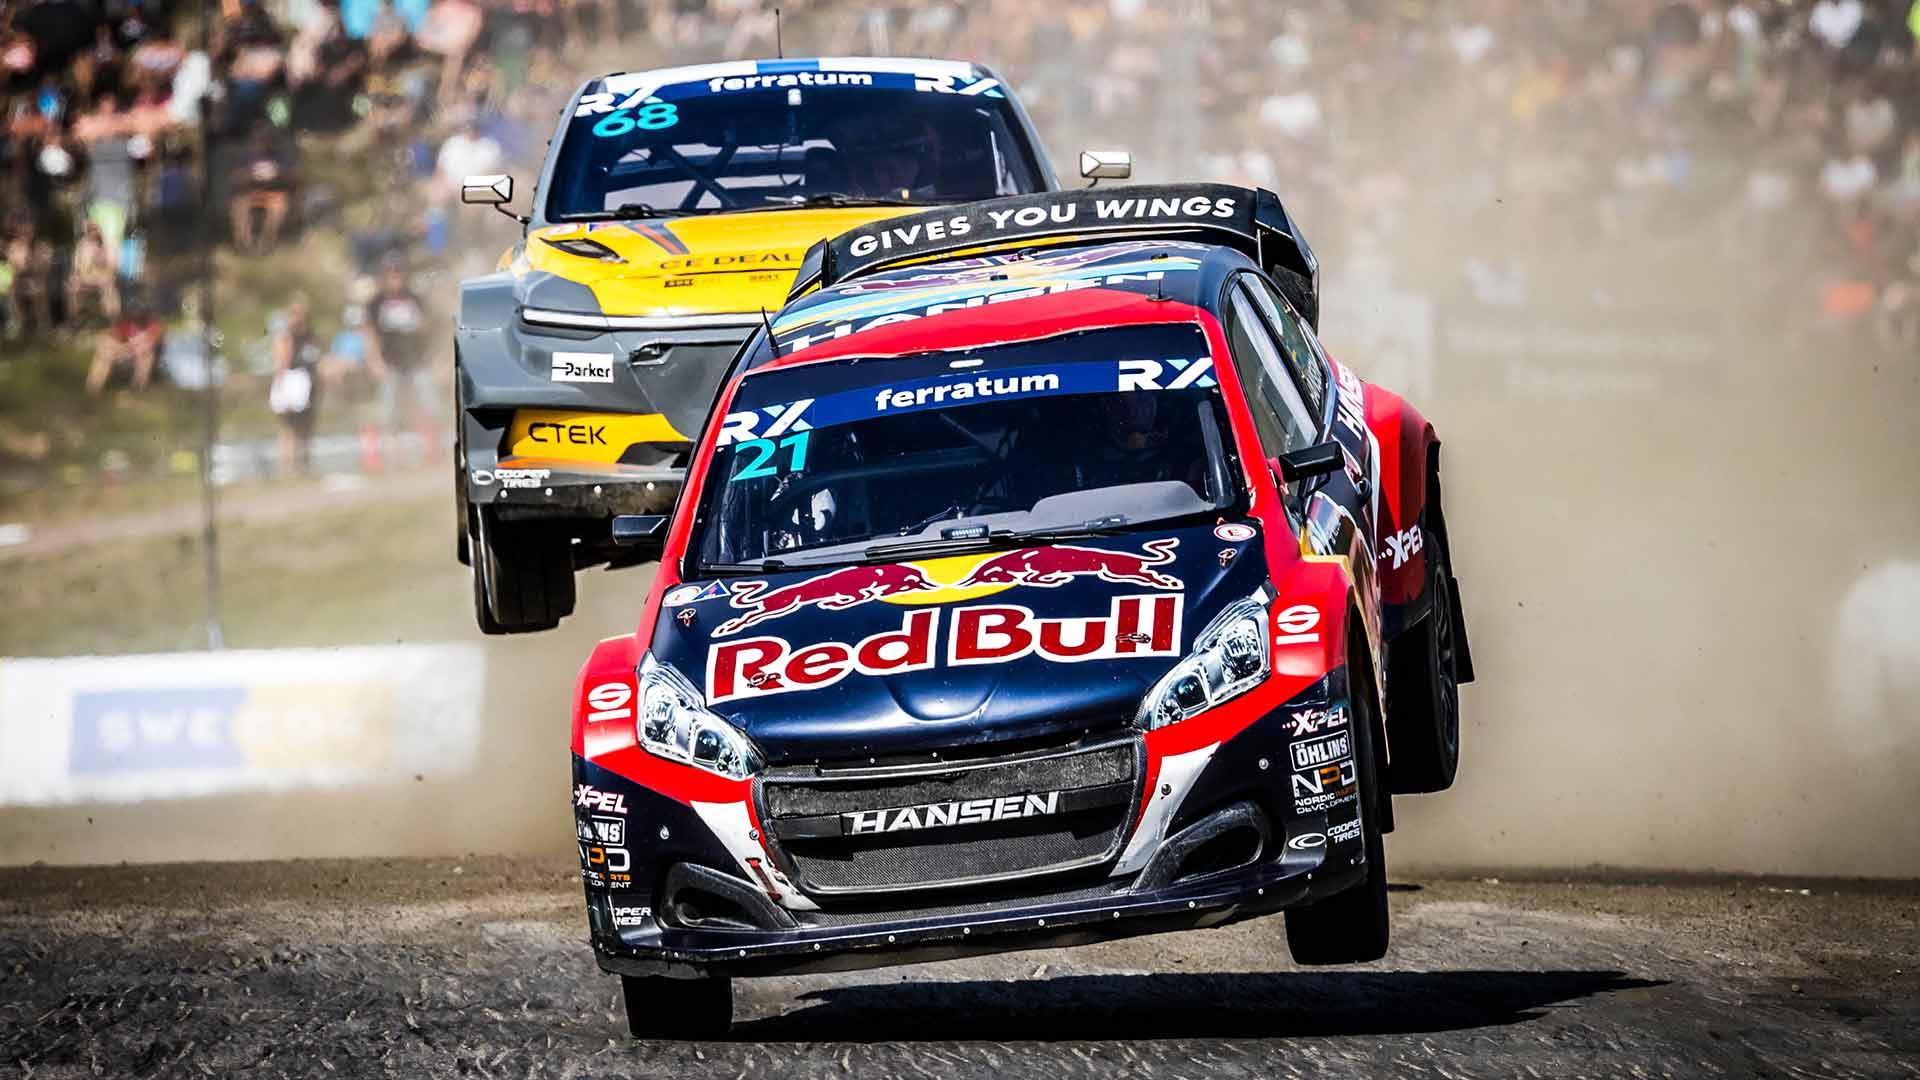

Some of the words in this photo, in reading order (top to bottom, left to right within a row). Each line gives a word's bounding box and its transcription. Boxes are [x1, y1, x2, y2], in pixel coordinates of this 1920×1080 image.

[708, 72, 873, 93] ferratum
[592, 103, 679, 137] 68
[849, 215, 971, 257] GIVES
[987, 202, 1077, 229] YOU
[1095, 196, 1236, 218] WINGS
[552, 362, 611, 379] Parker
[1118, 357, 1217, 392] RX
[874, 370, 1060, 411] ferratum
[528, 422, 607, 446] CTEK
[716, 398, 815, 446] RX
[731, 430, 809, 481] 21
[708, 607, 937, 703] Red
[952, 594, 1181, 668] Bull
[1288, 707, 1348, 737] XPEL
[1295, 735, 1348, 767] ÖHLINS
[575, 783, 628, 814] XPEL
[847, 791, 1060, 836] HANSEN
[1295, 792, 1336, 807] NORDIC
[1327, 818, 1361, 837] COOPE
